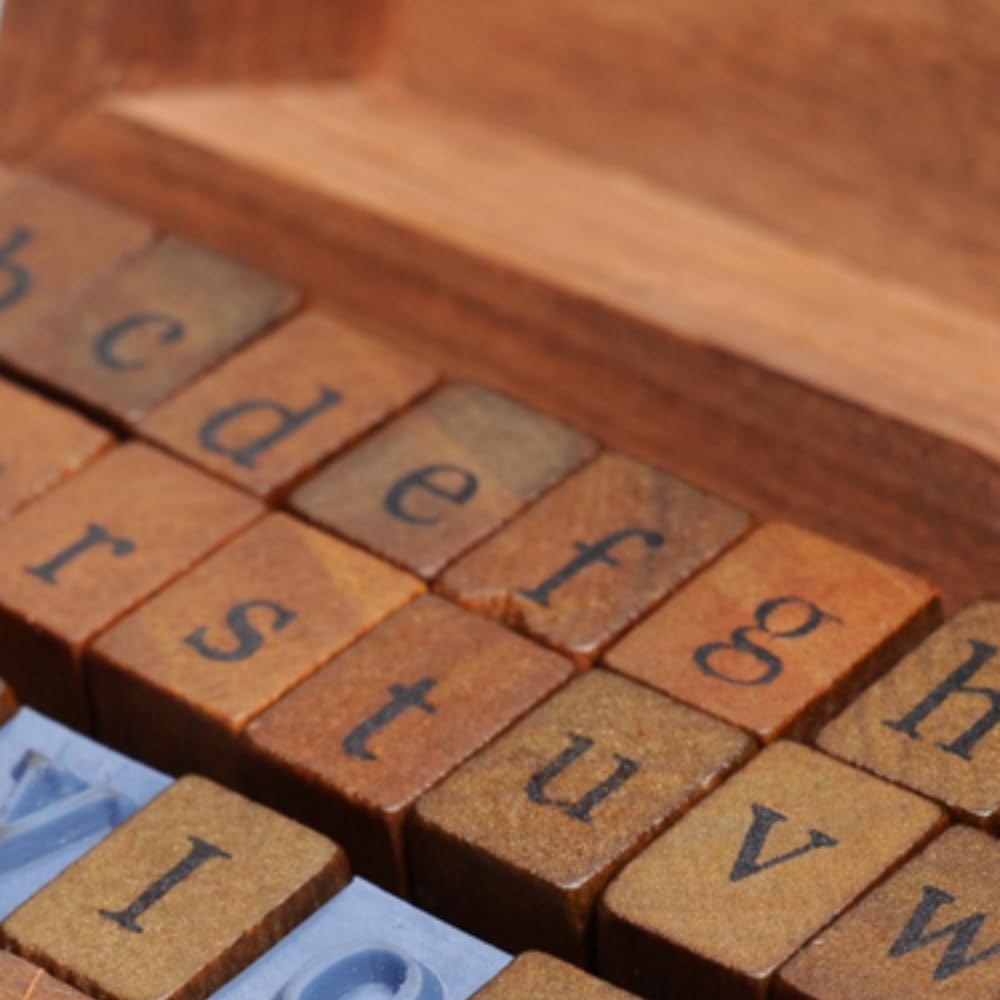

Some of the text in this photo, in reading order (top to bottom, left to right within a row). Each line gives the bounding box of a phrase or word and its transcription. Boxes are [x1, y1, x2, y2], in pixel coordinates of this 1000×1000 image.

[91, 312, 186, 371] c
[199, 389, 341, 469] d
[383, 467, 477, 524] e
[29, 524, 135, 584] r
[520, 528, 666, 605] f
[185, 601, 296, 661] s
[692, 598, 842, 685] g
[343, 677, 435, 760] t
[885, 640, 1000, 759] h
[526, 736, 639, 823] u
[730, 804, 838, 881] v
[98, 836, 232, 933] I
[889, 886, 1000, 980] w
